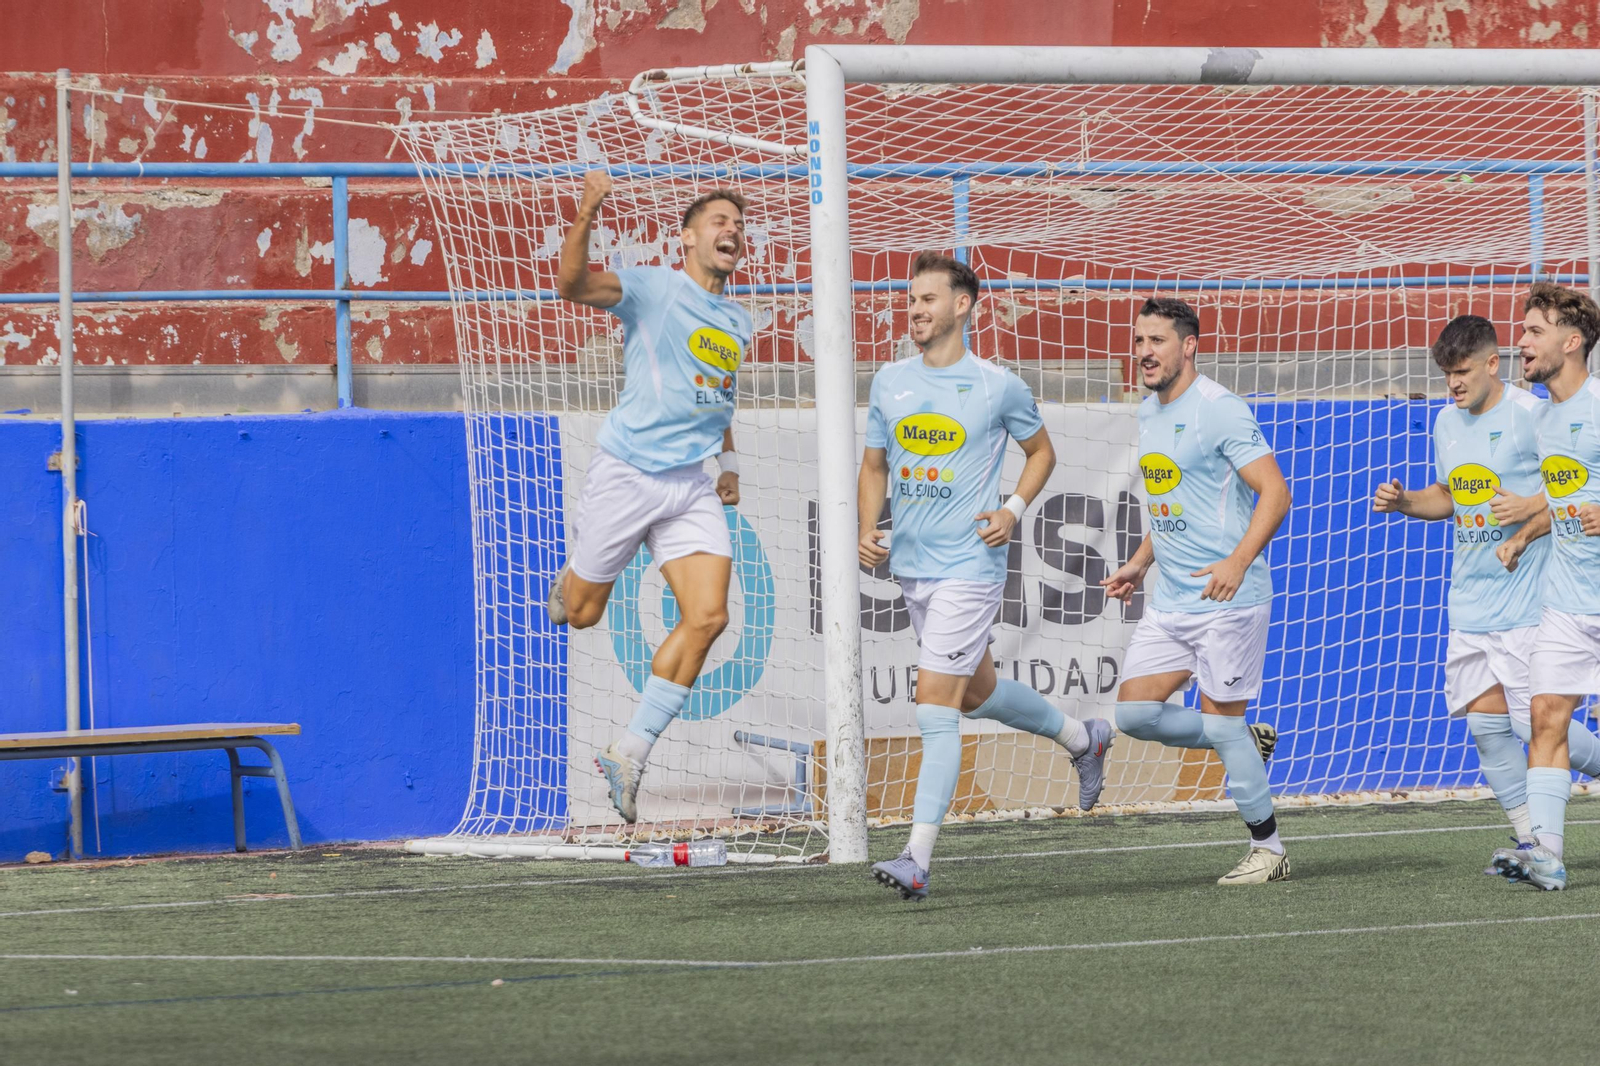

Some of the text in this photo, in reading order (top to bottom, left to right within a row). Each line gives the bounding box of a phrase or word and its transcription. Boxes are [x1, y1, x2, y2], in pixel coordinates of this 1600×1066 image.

[808, 121, 823, 205] MONDO
[698, 334, 738, 361] Magar
[696, 390, 711, 404] EL
[902, 425, 957, 445] Magar
[1140, 465, 1173, 484] Magar
[1543, 469, 1579, 485] Magar
[900, 482, 952, 499] EL EJIDO
[1452, 477, 1492, 495] Magar
[1457, 529, 1503, 543] EL EJIDO
